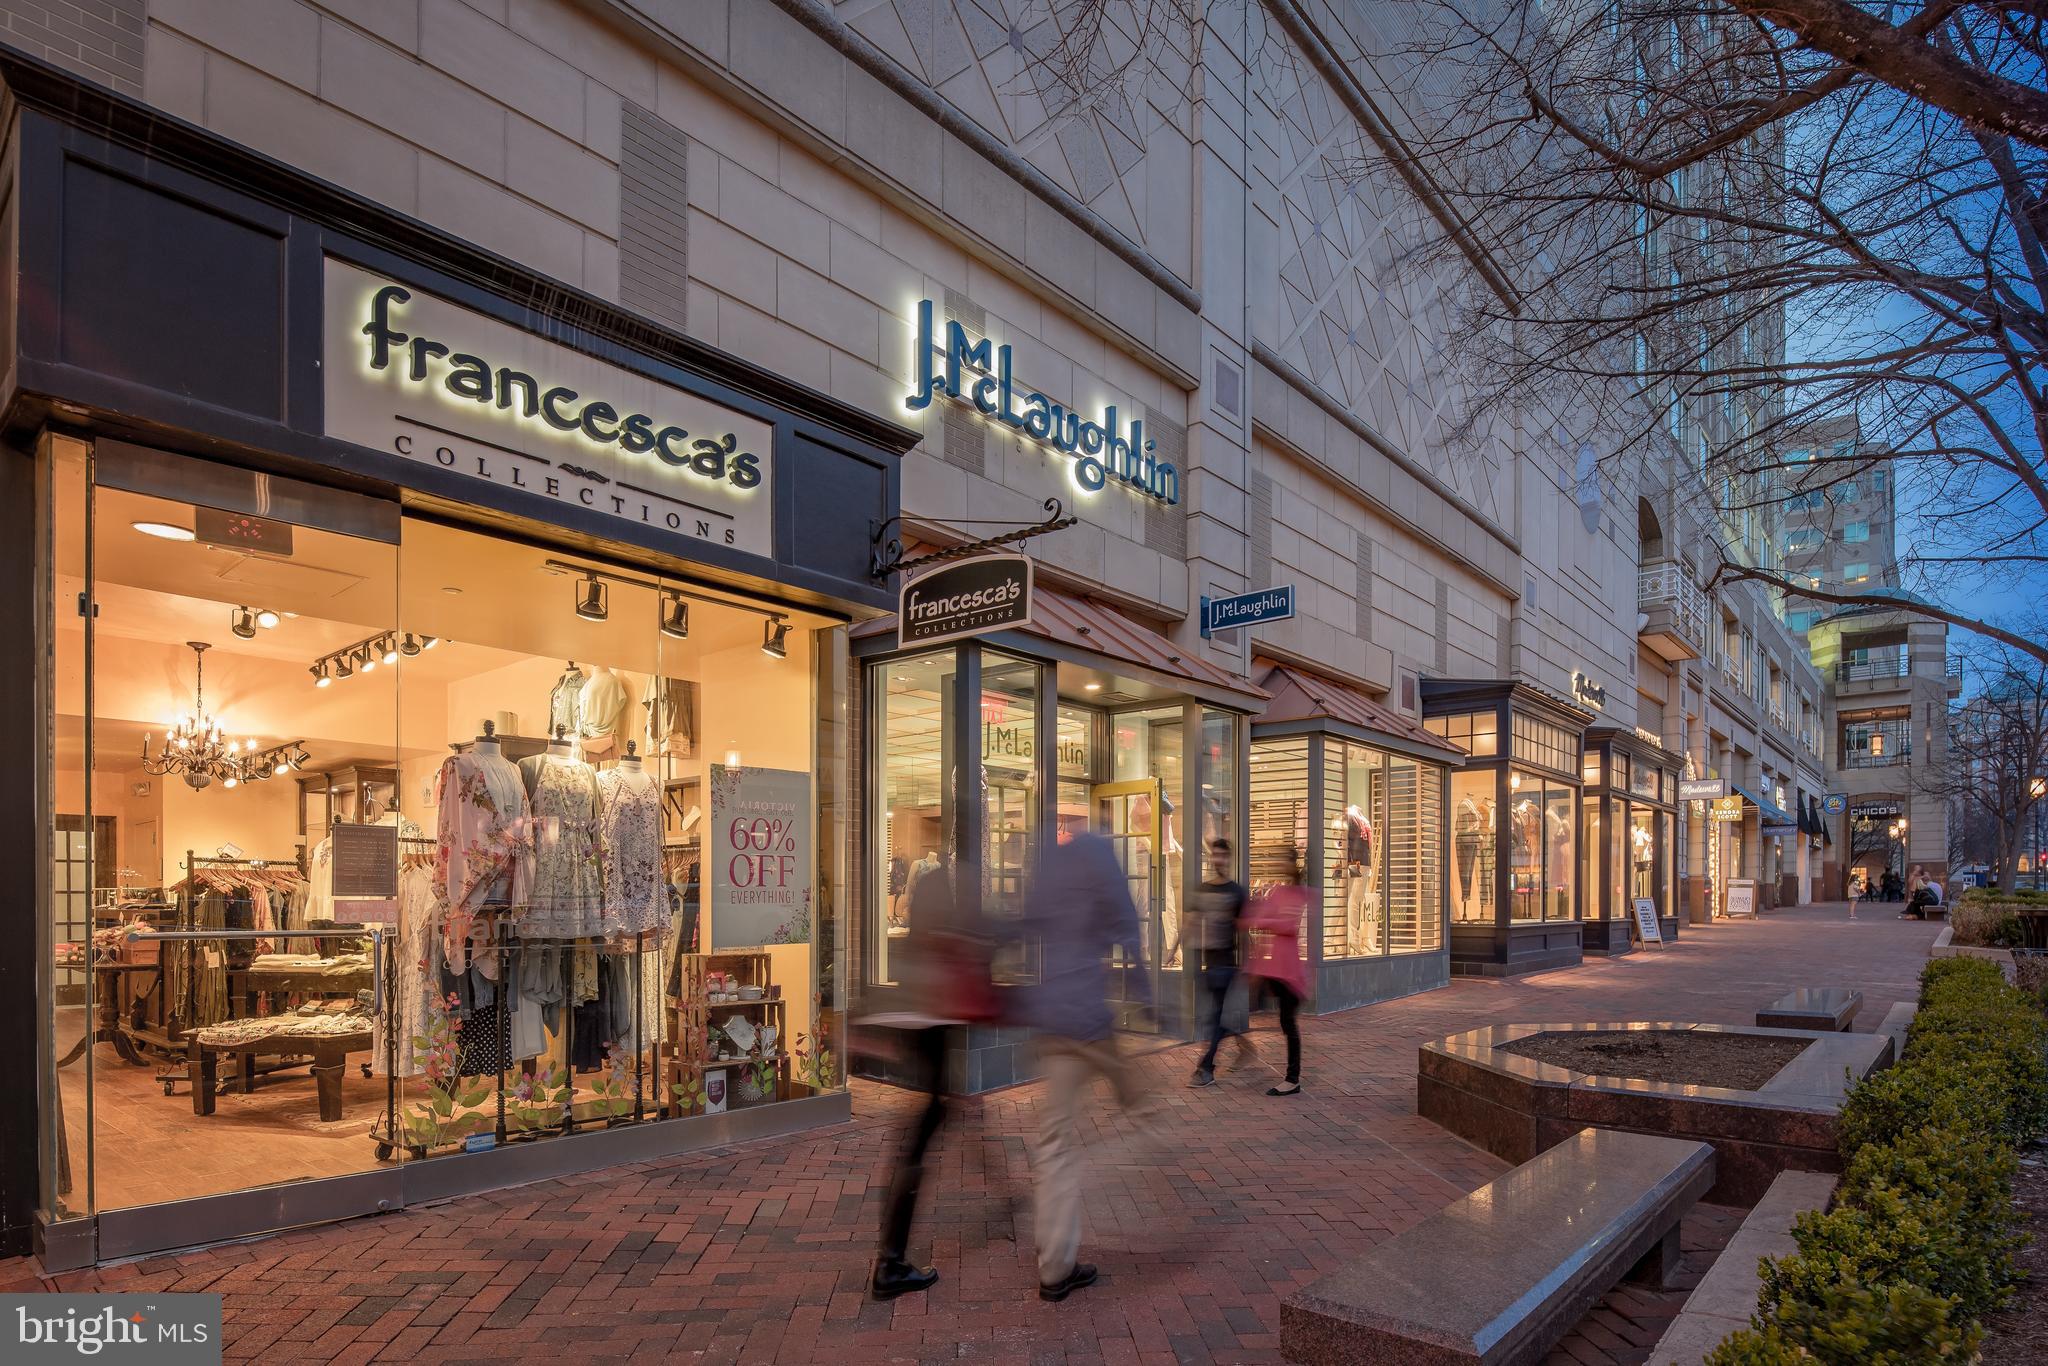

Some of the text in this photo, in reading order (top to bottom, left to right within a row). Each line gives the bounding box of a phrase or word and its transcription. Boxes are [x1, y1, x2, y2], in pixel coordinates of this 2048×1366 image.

[362, 286, 762, 490] francesca's
[906, 299, 1180, 506] J.McLaughlin
[395, 435, 736, 544] COLLECTIONS
[908, 578, 1020, 620] francesca's
[1214, 593, 1286, 625] J.McLaughlin
[915, 609, 1013, 636] COLLECTIONS
[1850, 806, 1897, 816] CHICO'S
[729, 816, 796, 852] 60%
[729, 853, 796, 889] OFF
[731, 889, 795, 905] EVERYTHING!
